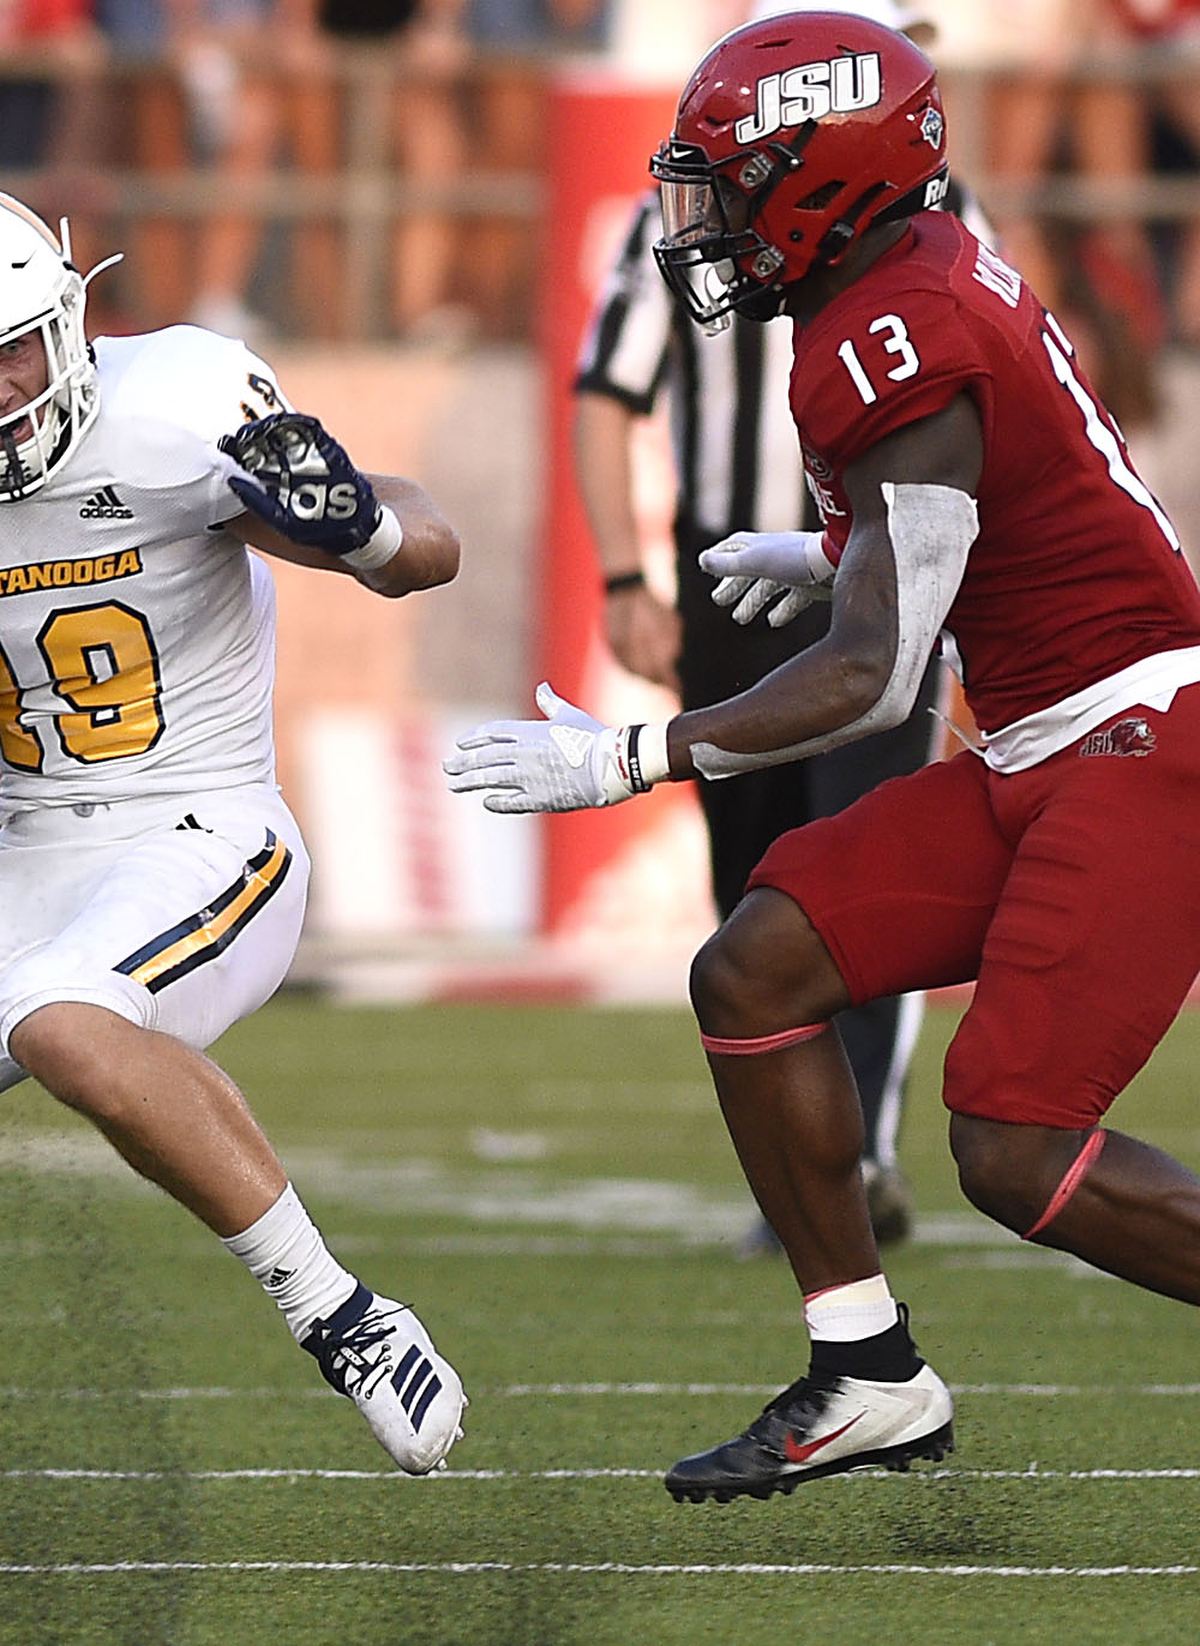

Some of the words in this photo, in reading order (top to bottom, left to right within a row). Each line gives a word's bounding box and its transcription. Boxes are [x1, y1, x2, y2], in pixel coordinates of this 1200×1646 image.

[734, 52, 882, 145] JSU
[837, 313, 920, 405] 13
[80, 507, 135, 519] adidas
